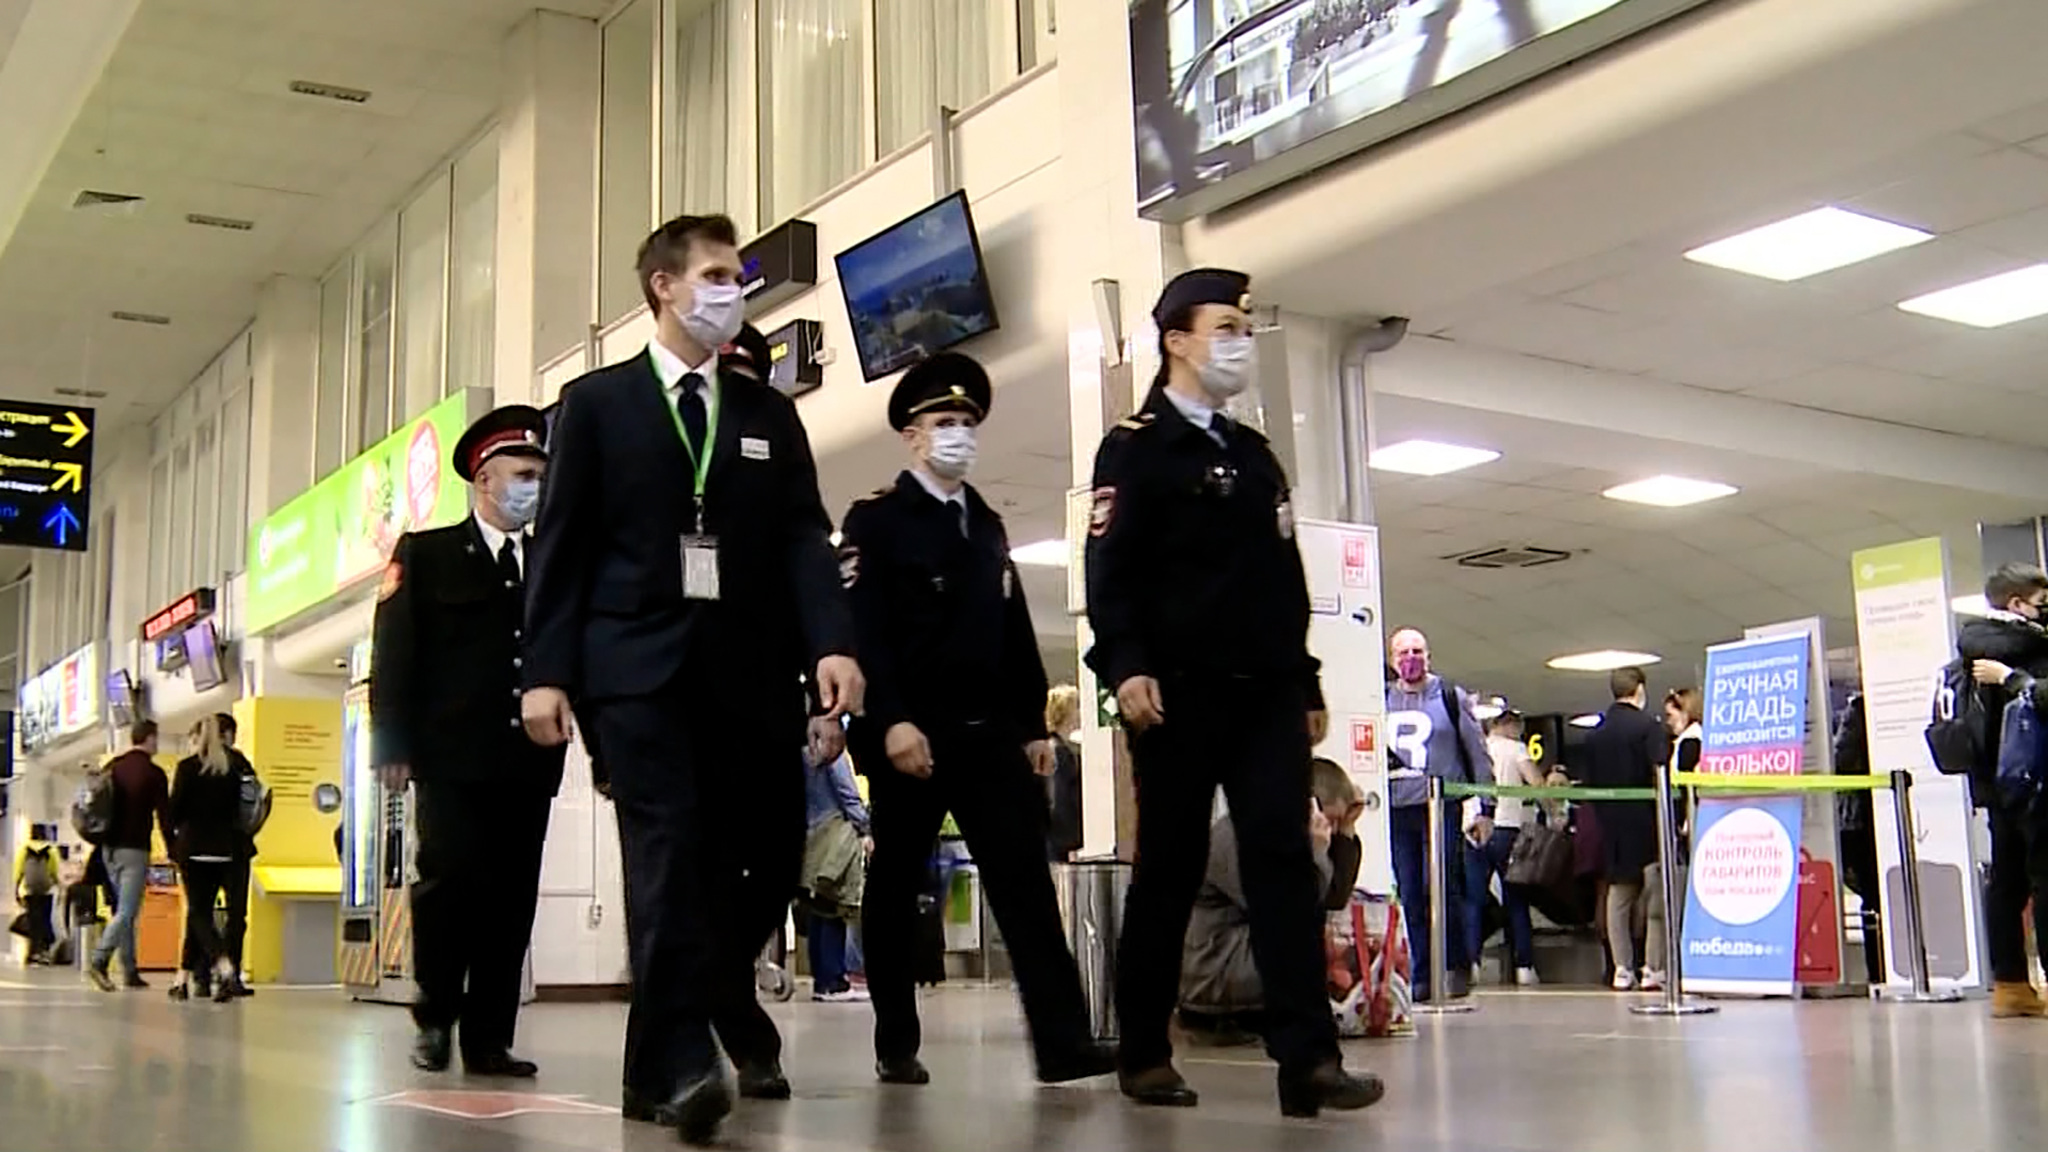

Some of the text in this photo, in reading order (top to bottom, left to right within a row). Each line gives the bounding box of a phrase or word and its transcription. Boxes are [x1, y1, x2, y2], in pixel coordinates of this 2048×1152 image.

[1713, 669, 1798, 698] РУЧНАЯ
[1711, 696, 1796, 726] КЛАДЬ
[1388, 711, 1432, 768] R
[1528, 734, 1543, 761] 6
[1709, 725, 1795, 745] ПРОВОЗИТСЯ
[1704, 846, 1783, 861] КОНТРОЛЬ
[1702, 864, 1782, 880] ГАБАРИТОВ
